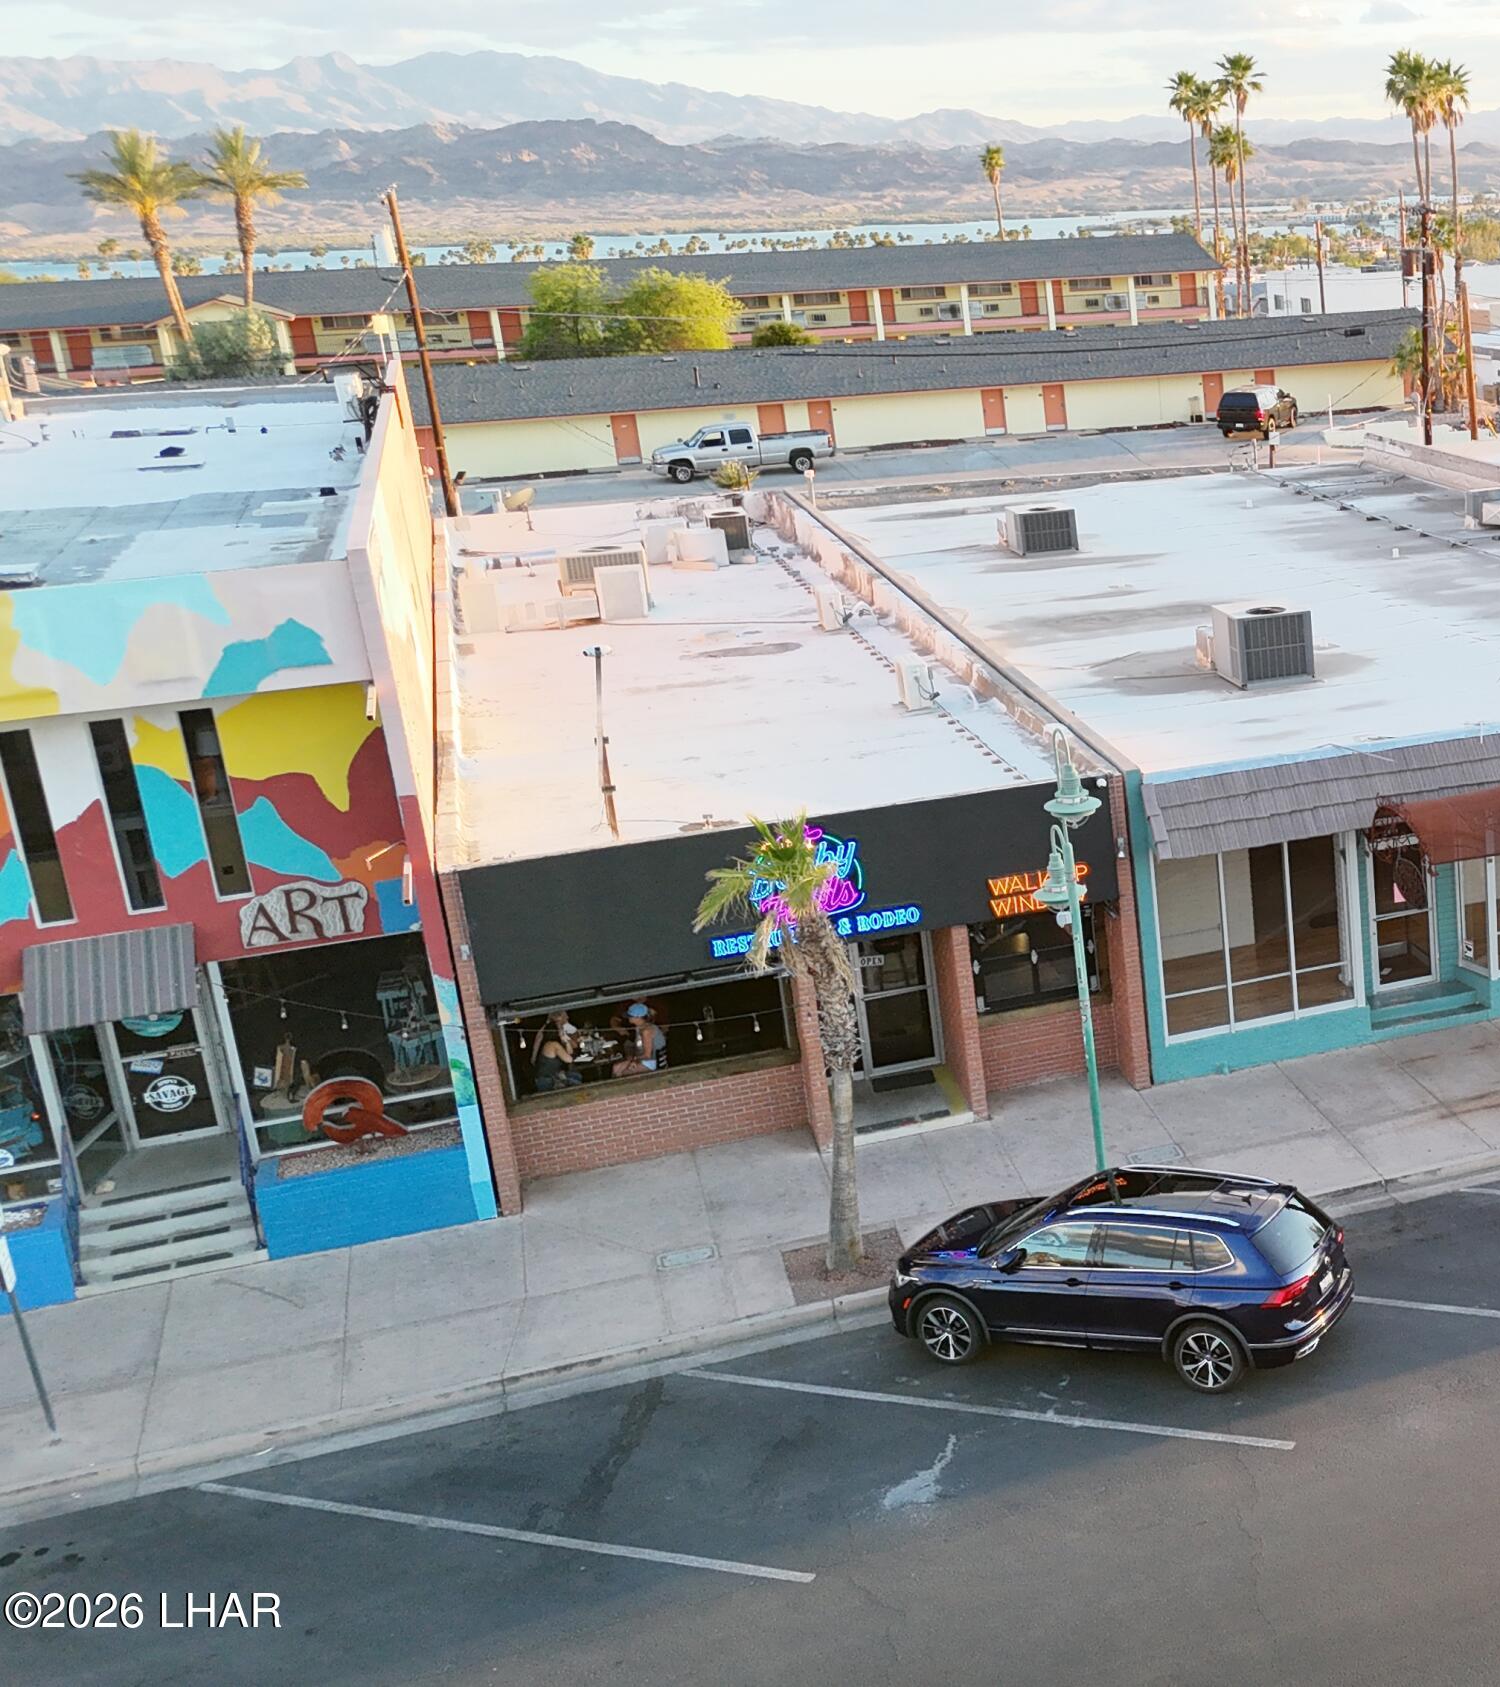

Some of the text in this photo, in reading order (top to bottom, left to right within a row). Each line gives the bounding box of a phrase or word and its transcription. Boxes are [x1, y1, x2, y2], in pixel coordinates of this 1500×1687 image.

[246, 887, 364, 947] ART
[838, 917, 853, 936] &
[856, 906, 920, 933] RODEO
[860, 957, 882, 966] OPEN
[148, 1087, 191, 1102] SAVAGE
